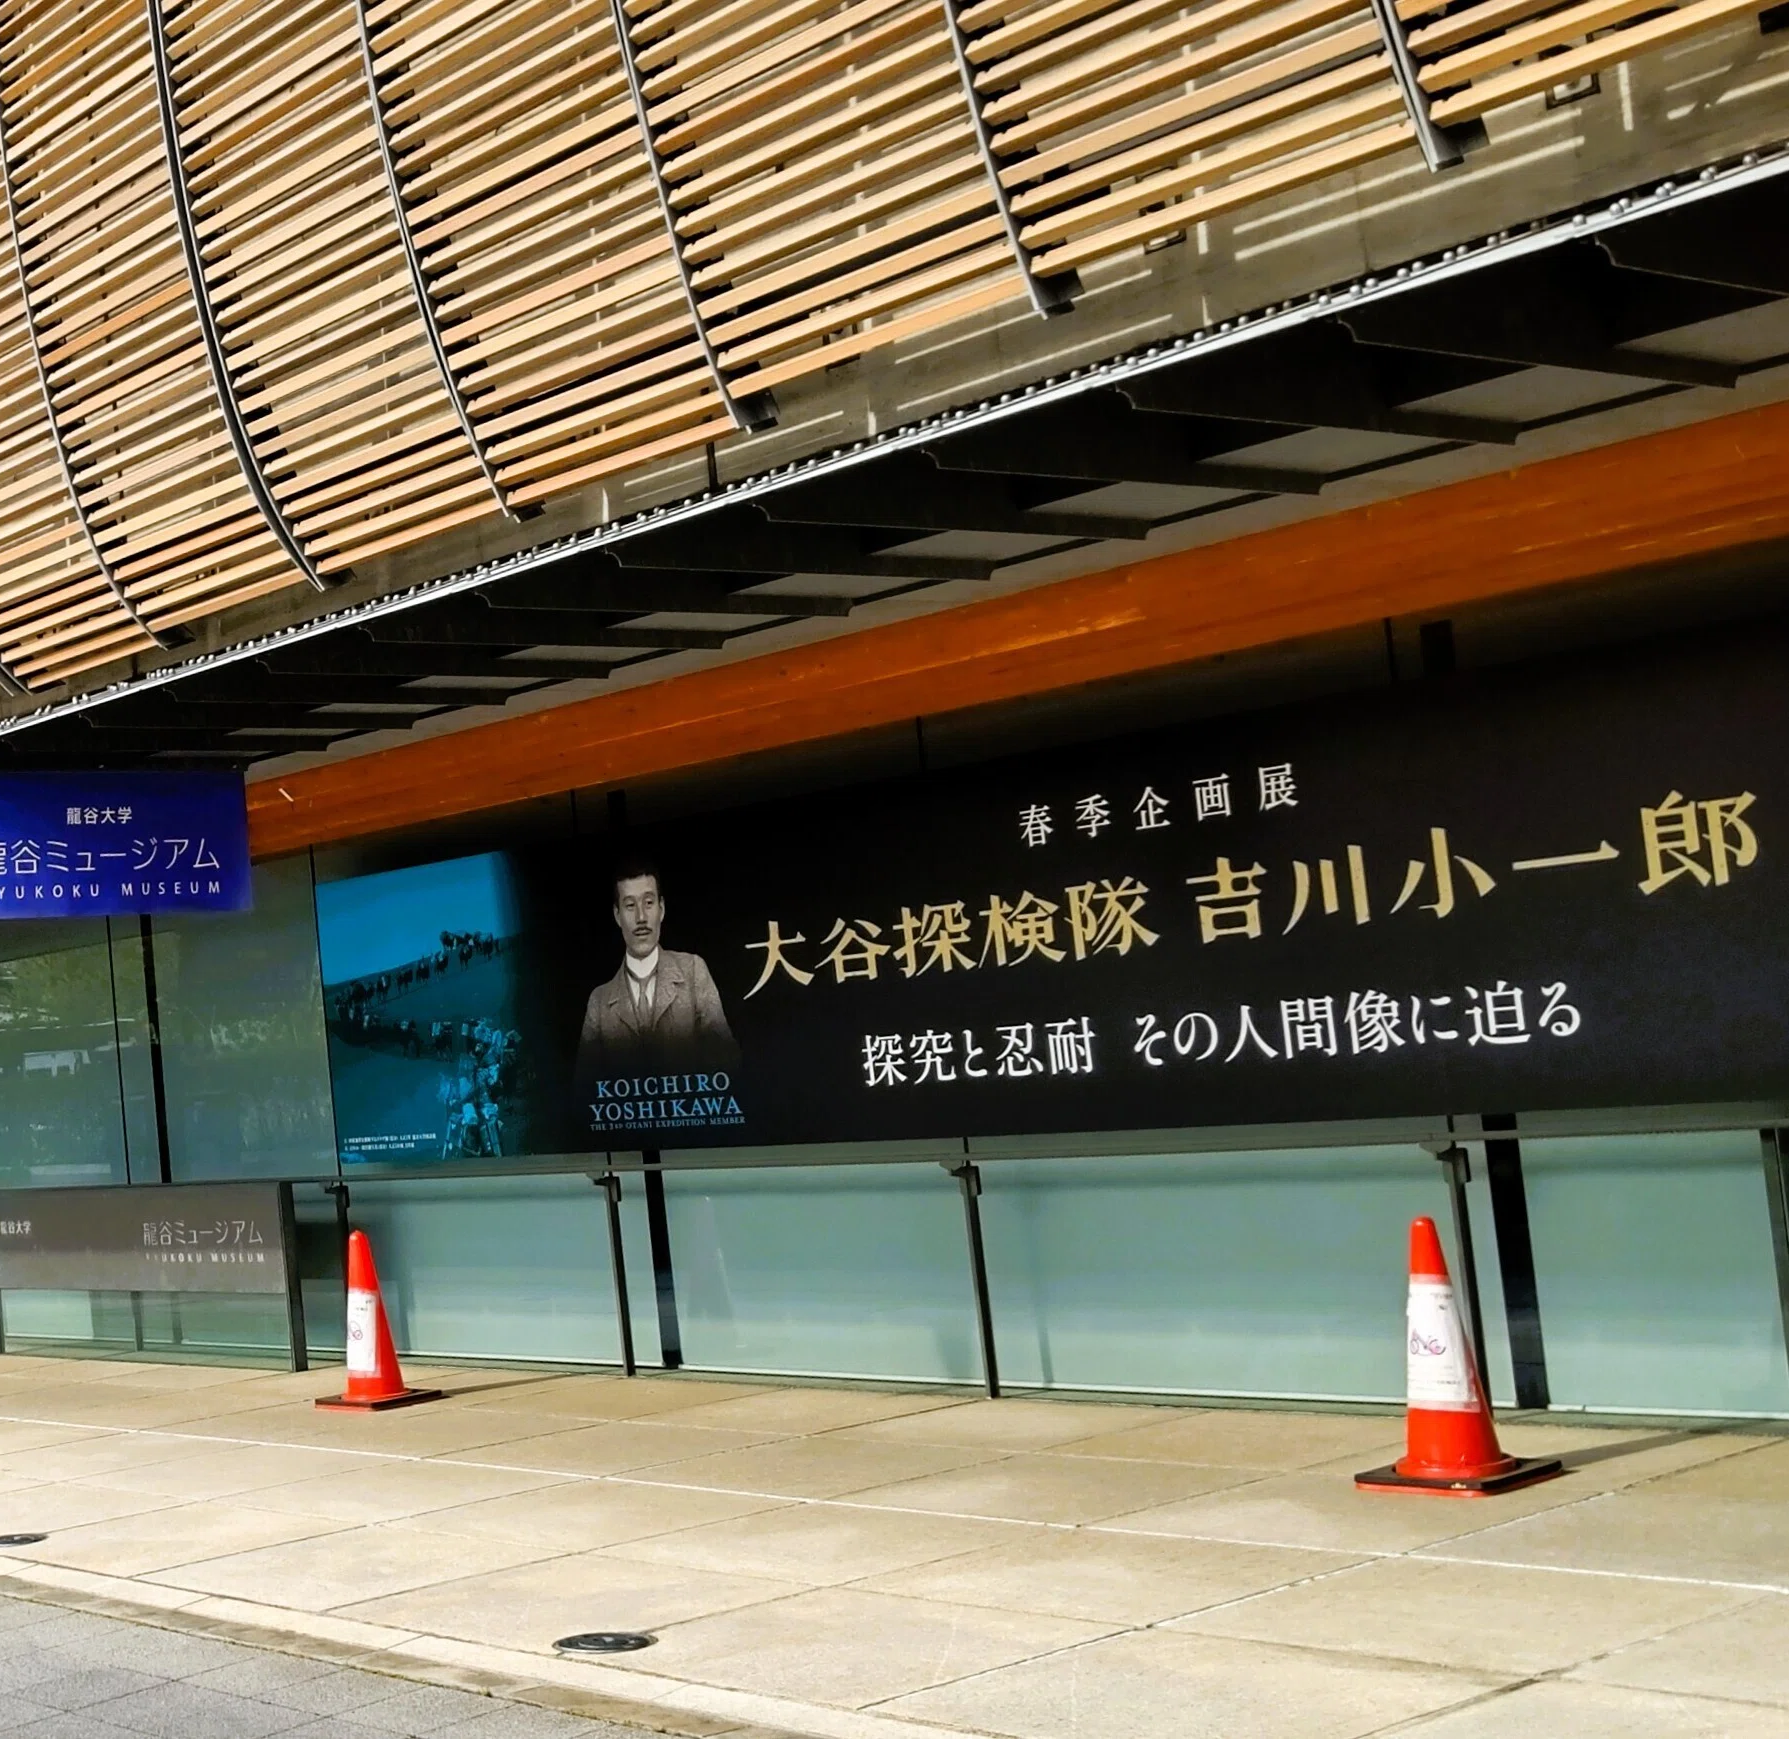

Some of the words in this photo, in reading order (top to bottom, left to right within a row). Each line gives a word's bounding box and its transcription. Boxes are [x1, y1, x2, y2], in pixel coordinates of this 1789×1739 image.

[66, 806, 133, 825] 龍谷大学
[1018, 762, 1299, 848] 春季企画展
[121, 881, 221, 897] MUSEUM
[742, 875, 1161, 1000] 大谷探検隊
[1185, 789, 1759, 945] 吉川小一郎
[861, 1015, 1096, 1088] 探究と忍耐
[1133, 979, 1583, 1068] その人間像に迫る
[596, 1071, 730, 1099] KOICHIRO
[589, 1096, 743, 1122] YOSHIKAWA
[590, 1123, 607, 1131] THE
[625, 1121, 653, 1130] OTANI
[655, 1118, 706, 1128] EXPEDITION
[709, 1116, 746, 1125] MEMBER
[0, 1220, 32, 1235] 龍谷大学
[143, 1220, 263, 1246] 龍谷ミュージアム
[210, 1252, 266, 1263] MUSEUM
